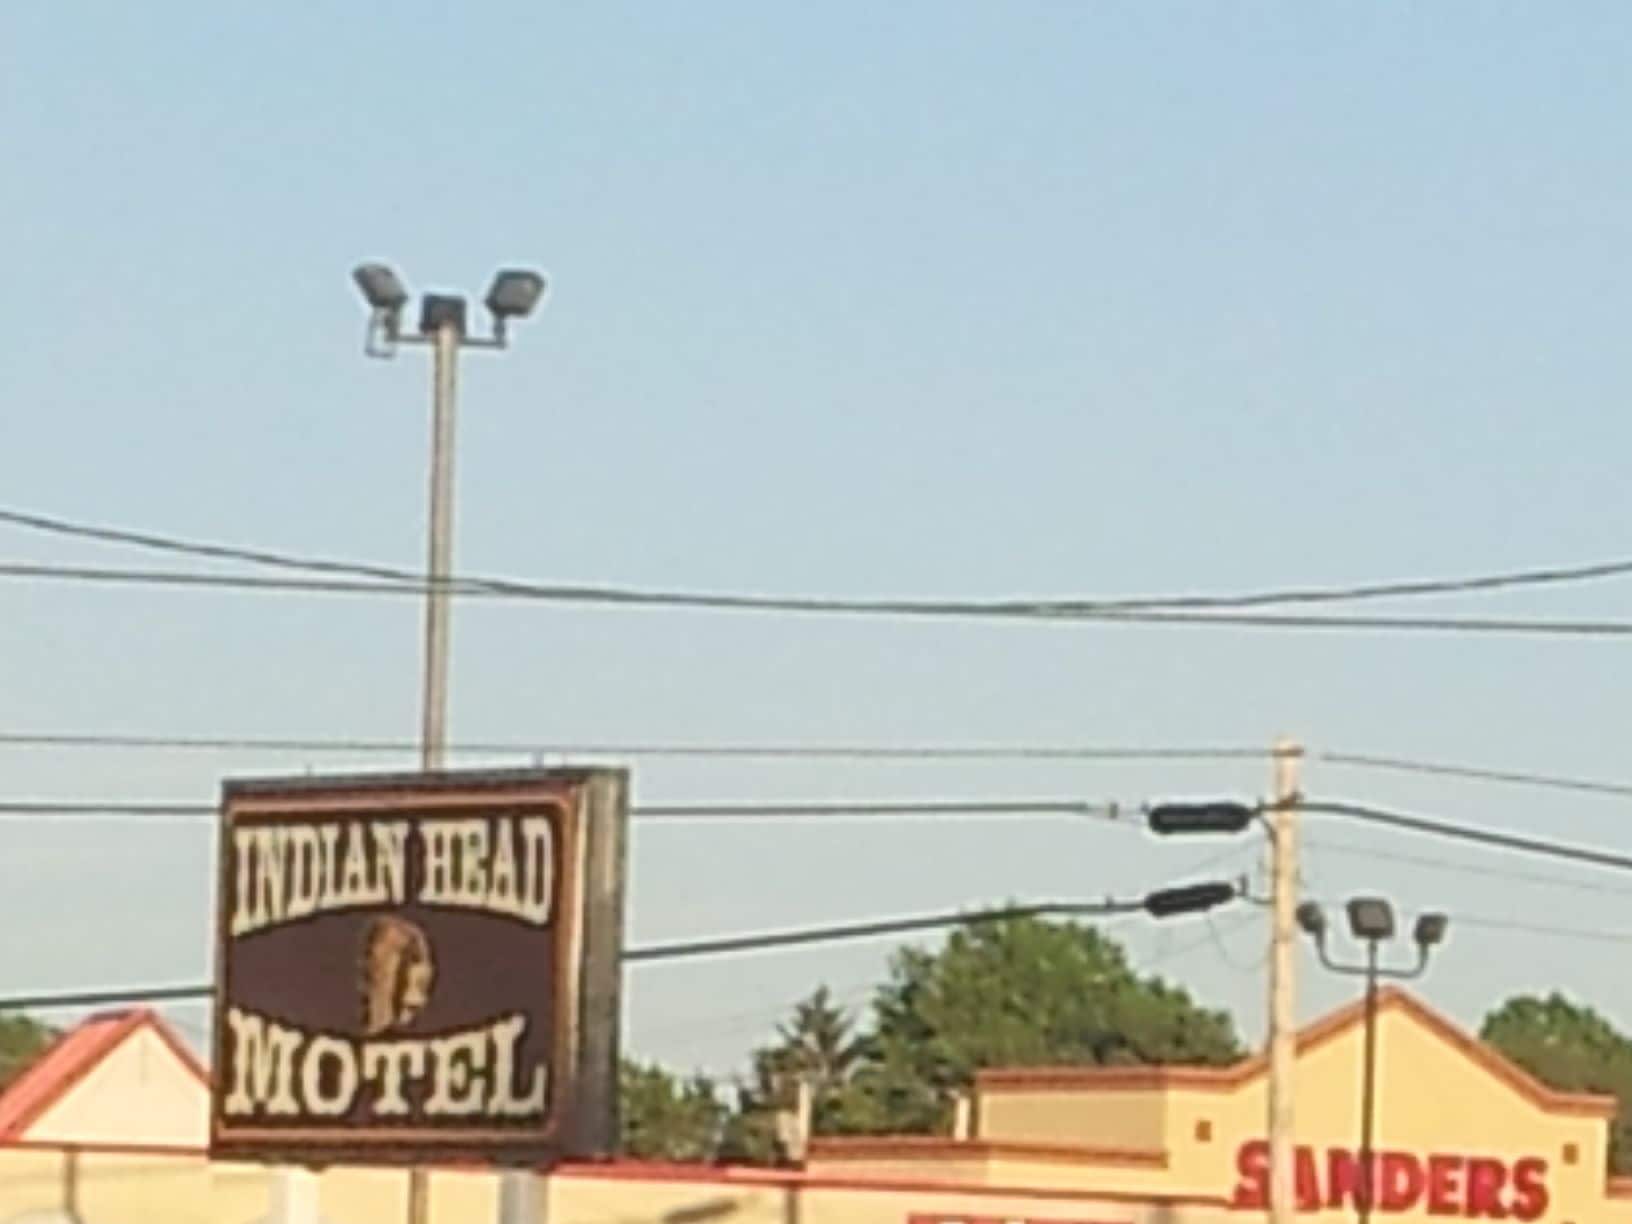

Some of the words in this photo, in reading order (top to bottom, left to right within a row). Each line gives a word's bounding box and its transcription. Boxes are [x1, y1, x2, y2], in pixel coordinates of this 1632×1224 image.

[231, 819, 409, 937] INDIAN
[418, 815, 553, 925] HEAD
[224, 1006, 546, 1116] MOTEL
[1230, 1140, 1550, 1223] SANDERS
